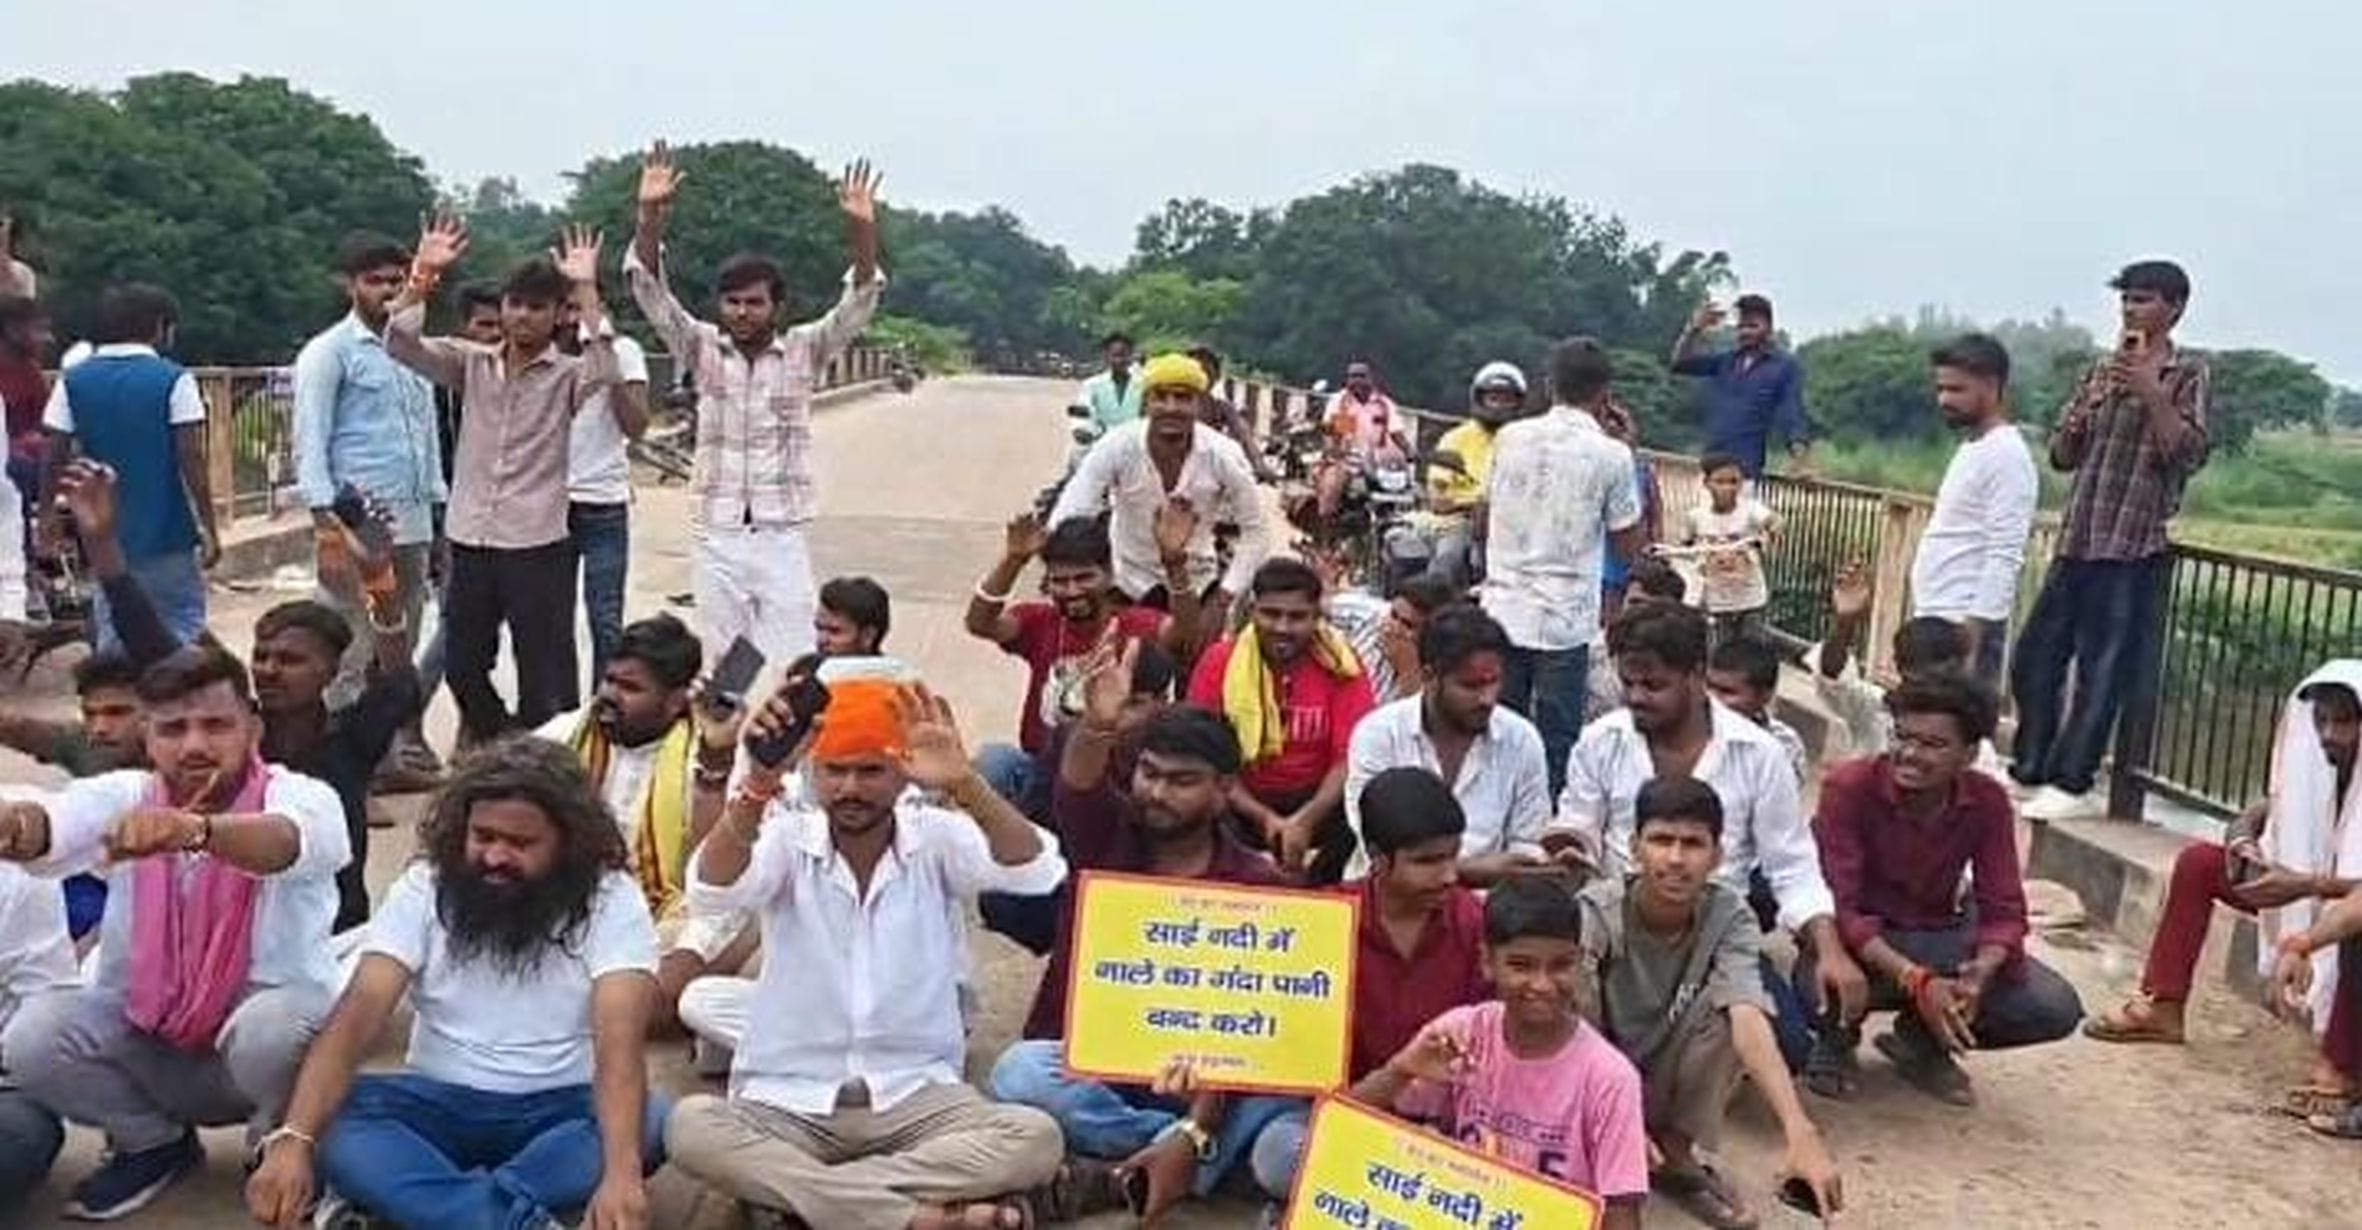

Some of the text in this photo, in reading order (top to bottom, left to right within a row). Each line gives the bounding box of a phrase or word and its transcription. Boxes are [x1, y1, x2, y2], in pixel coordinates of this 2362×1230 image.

[1207, 922, 1258, 951] नदी
[1266, 928, 1296, 953] में
[1095, 959, 1331, 998] नाले का गंदा पानी
[1147, 1008, 1201, 1031] बन्द
[1314, 1189, 1371, 1229] नाले
[1428, 1186, 1483, 1226] नदी
